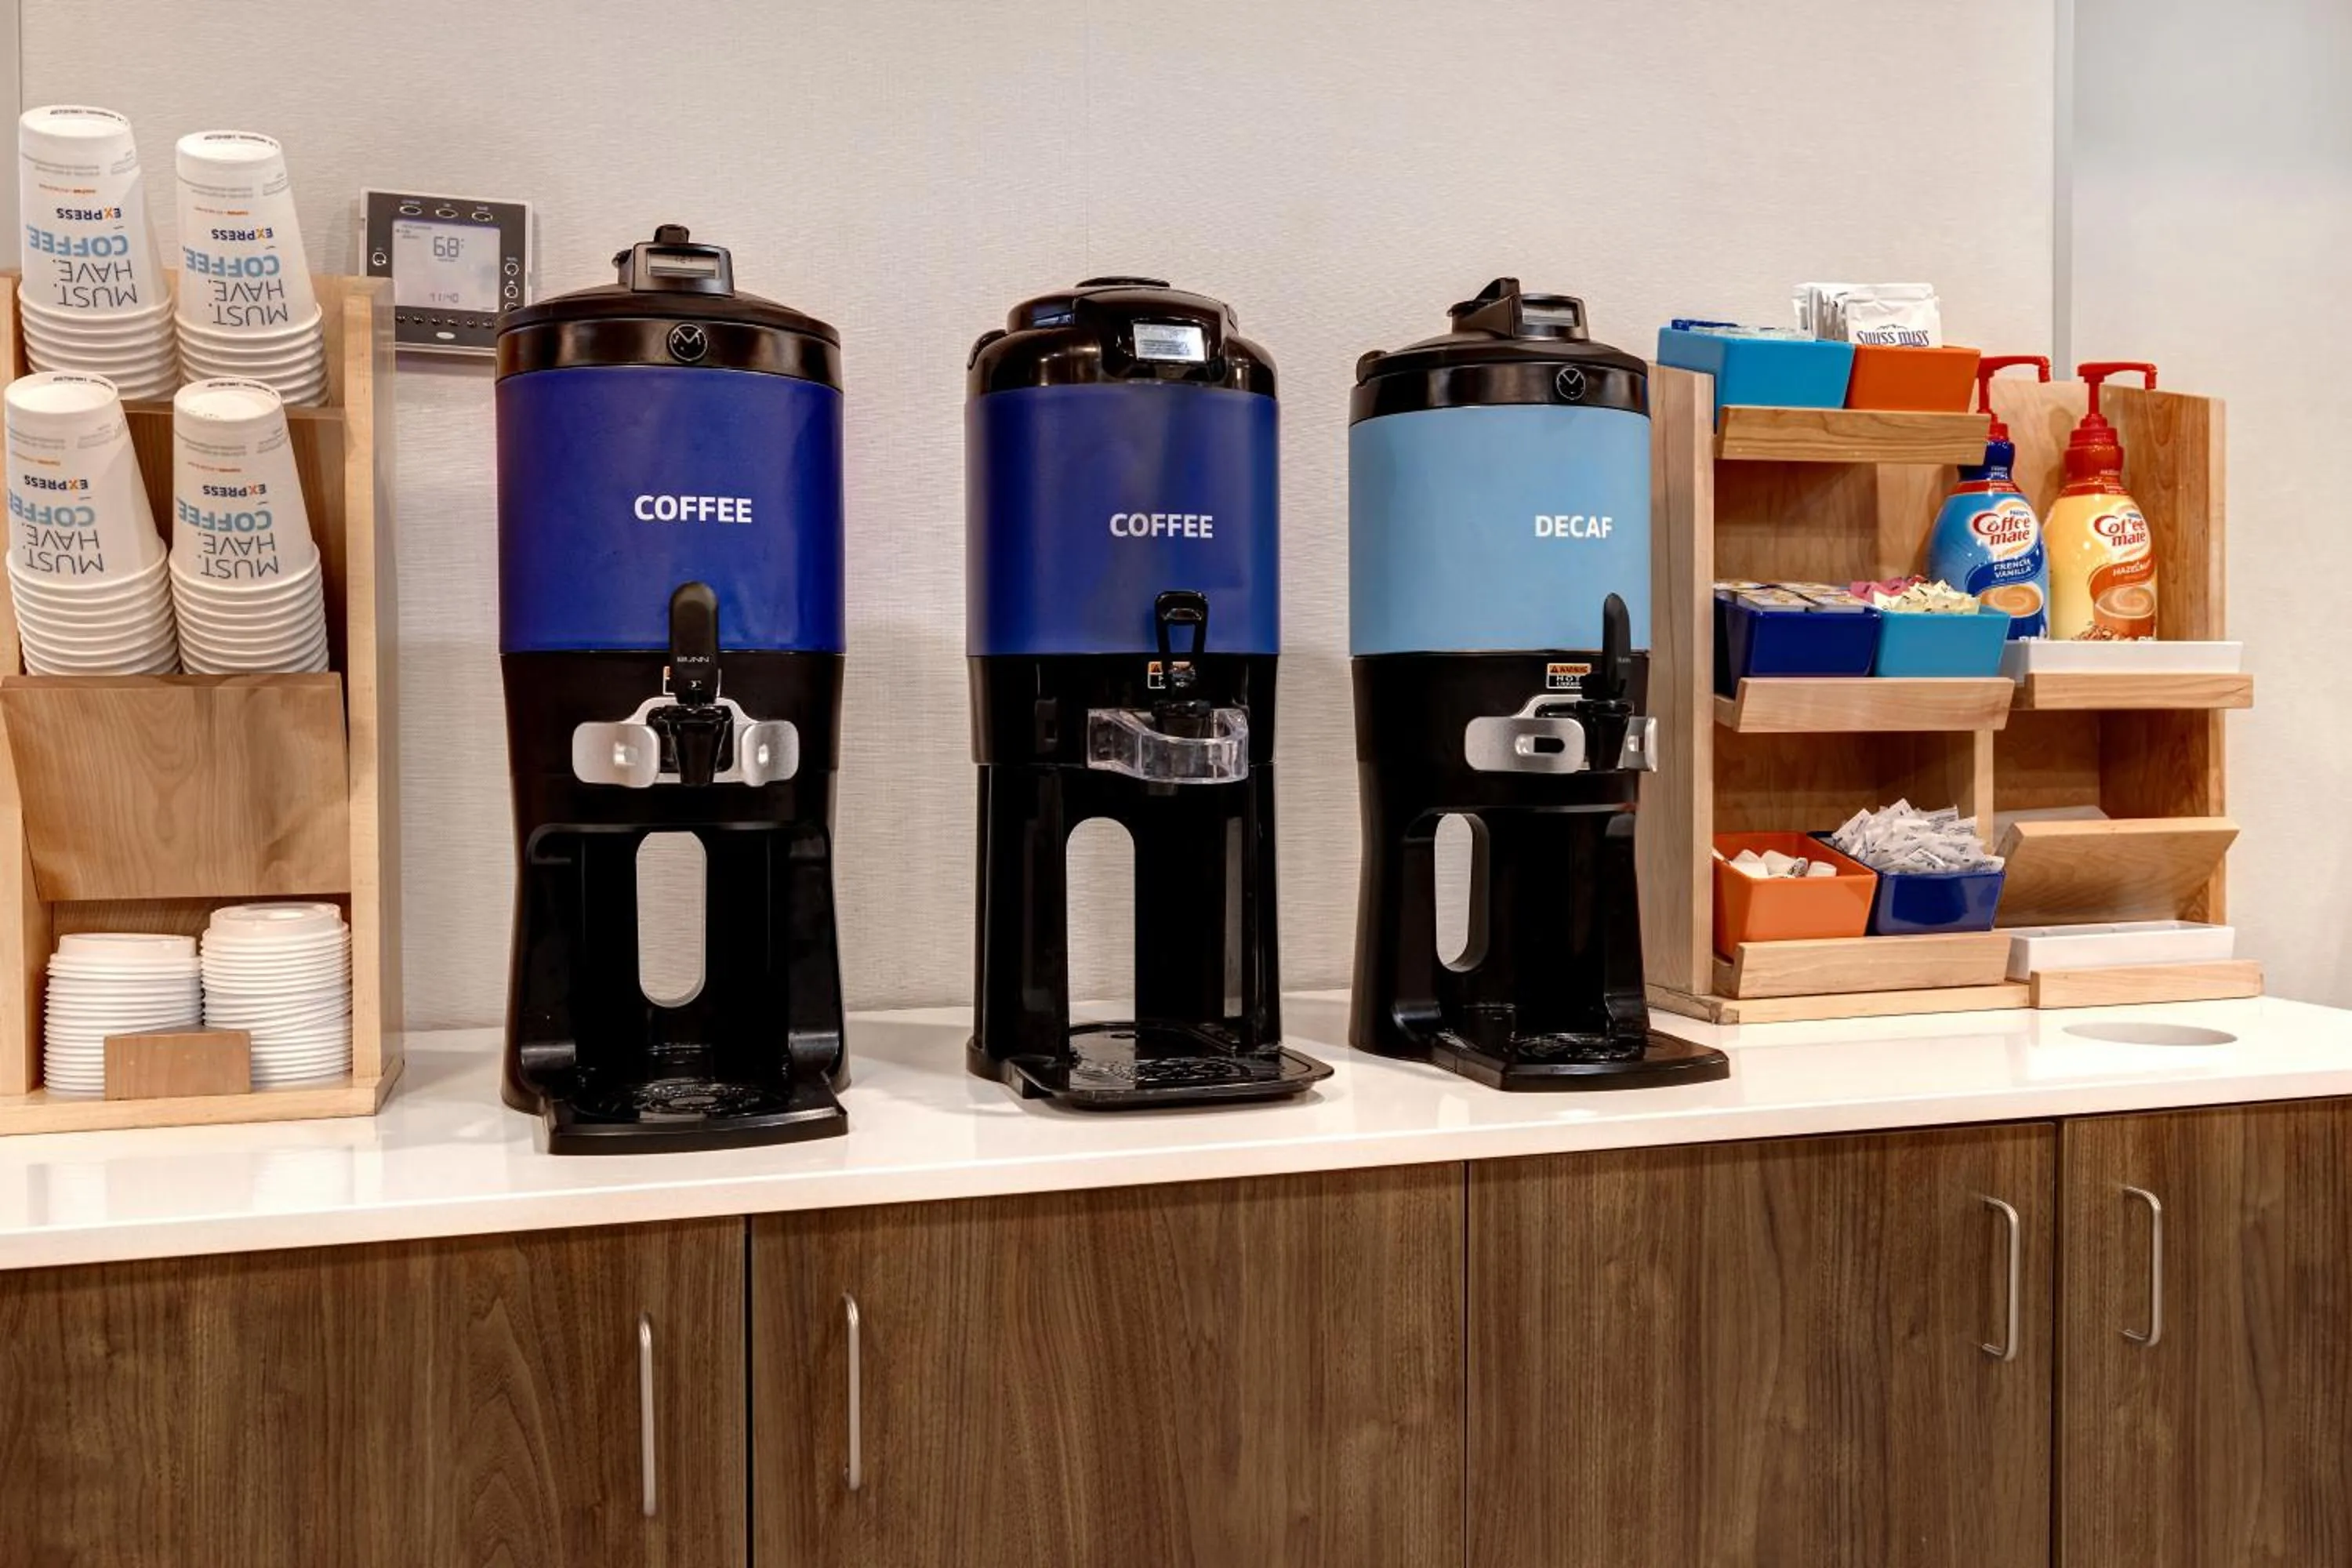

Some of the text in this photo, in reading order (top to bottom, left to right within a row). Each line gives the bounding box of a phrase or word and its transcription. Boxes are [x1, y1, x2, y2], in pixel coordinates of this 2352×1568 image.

[56, 207, 122, 221] EXPRESS
[211, 227, 274, 241] EXPRESS
[53, 259, 133, 284] HAVE.
[183, 245, 280, 278] COFFEE.
[53, 283, 138, 308] MUST.
[208, 279, 284, 303] HAVE.
[209, 303, 289, 327] MUST.
[24, 474, 89, 491] EXPRESS
[203, 484, 266, 498] EXPRESS
[634, 495, 753, 523] COFFEE
[1109, 513, 1214, 538] COFFEE
[1534, 514, 1613, 538] DECAF
[1973, 512, 2031, 535] Coffee
[21, 523, 100, 550] HAVE.
[198, 532, 276, 556] HAVE.
[1990, 529, 2031, 546] mate
[2111, 532, 2146, 546] mate
[23, 545, 105, 574] MUST.
[198, 555, 279, 579] MUST.
[1994, 558, 2031, 571] FRENCH
[1994, 565, 2032, 578] VANILLA
